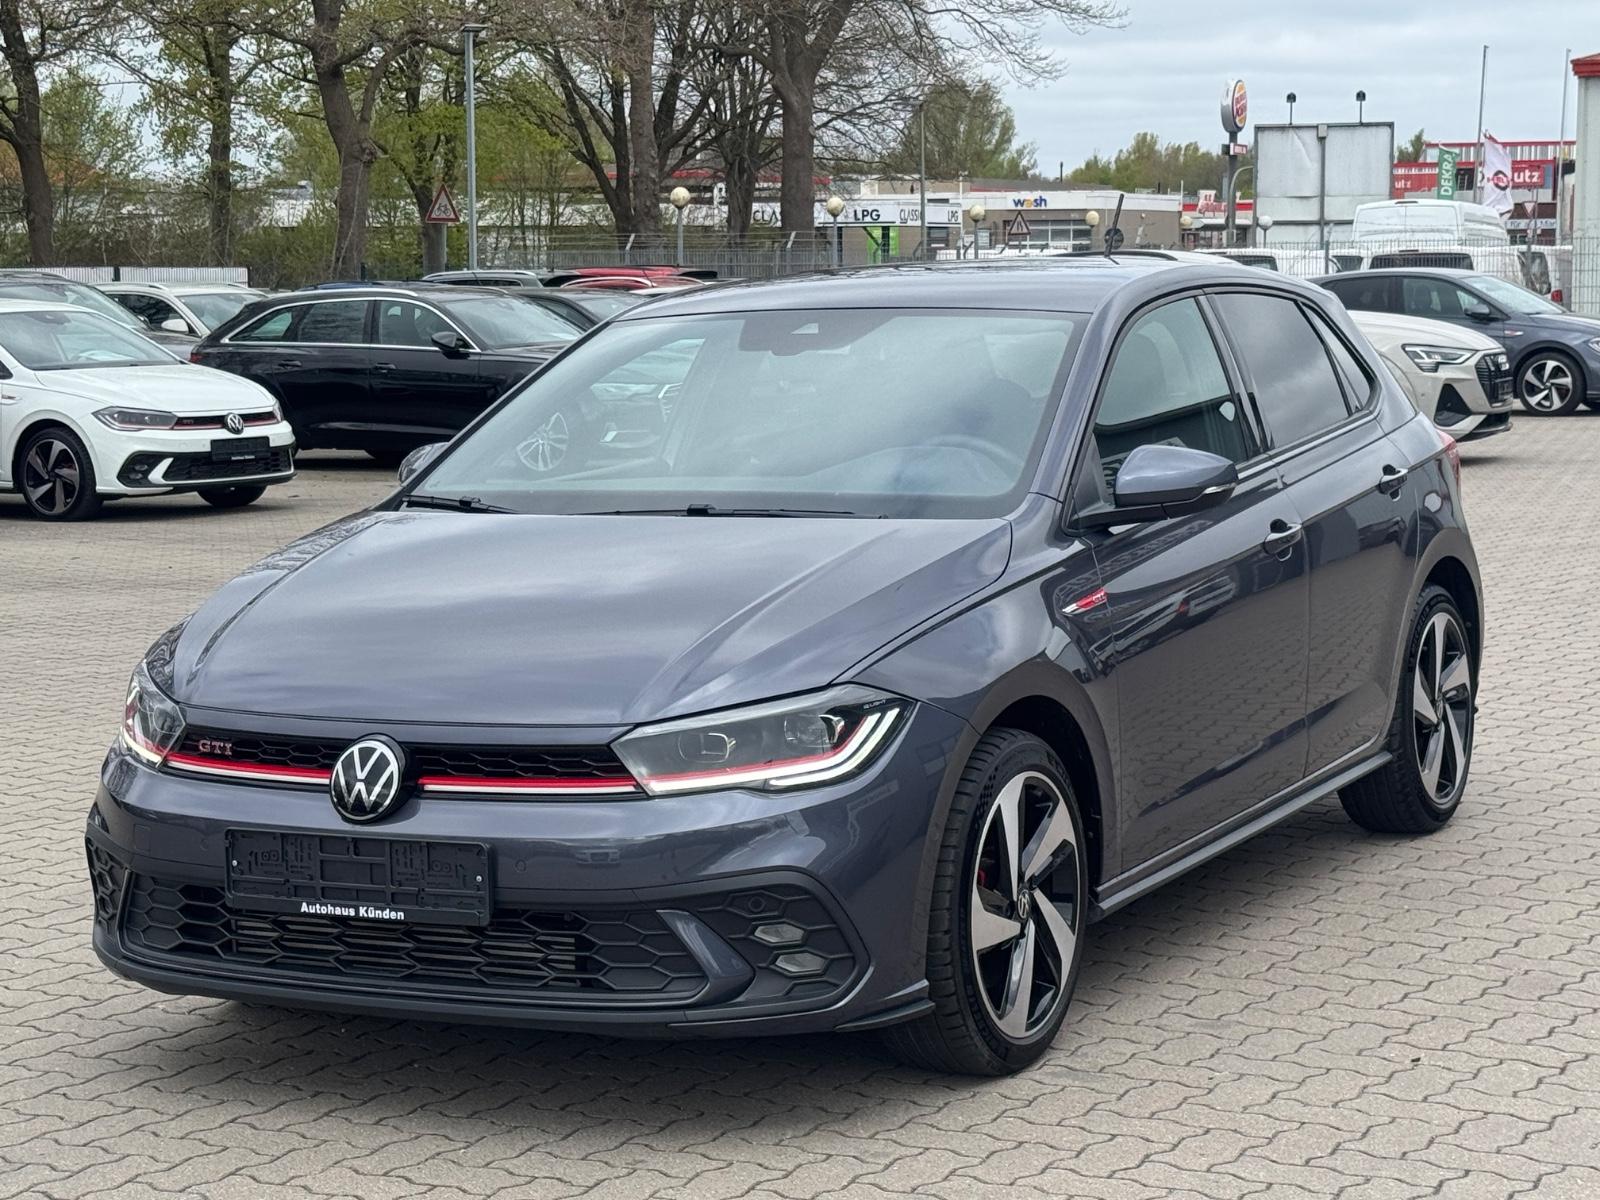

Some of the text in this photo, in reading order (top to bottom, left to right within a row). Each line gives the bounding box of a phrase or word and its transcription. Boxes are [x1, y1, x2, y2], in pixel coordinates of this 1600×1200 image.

[1441, 154, 1453, 195] DEKRA
[1013, 195, 1047, 208] wash
[753, 209, 880, 225] CLA LPG
[899, 207, 959, 224] CLASSI LPG
[199, 740, 232, 755] GTI
[301, 902, 405, 920] Autohaus Künden
